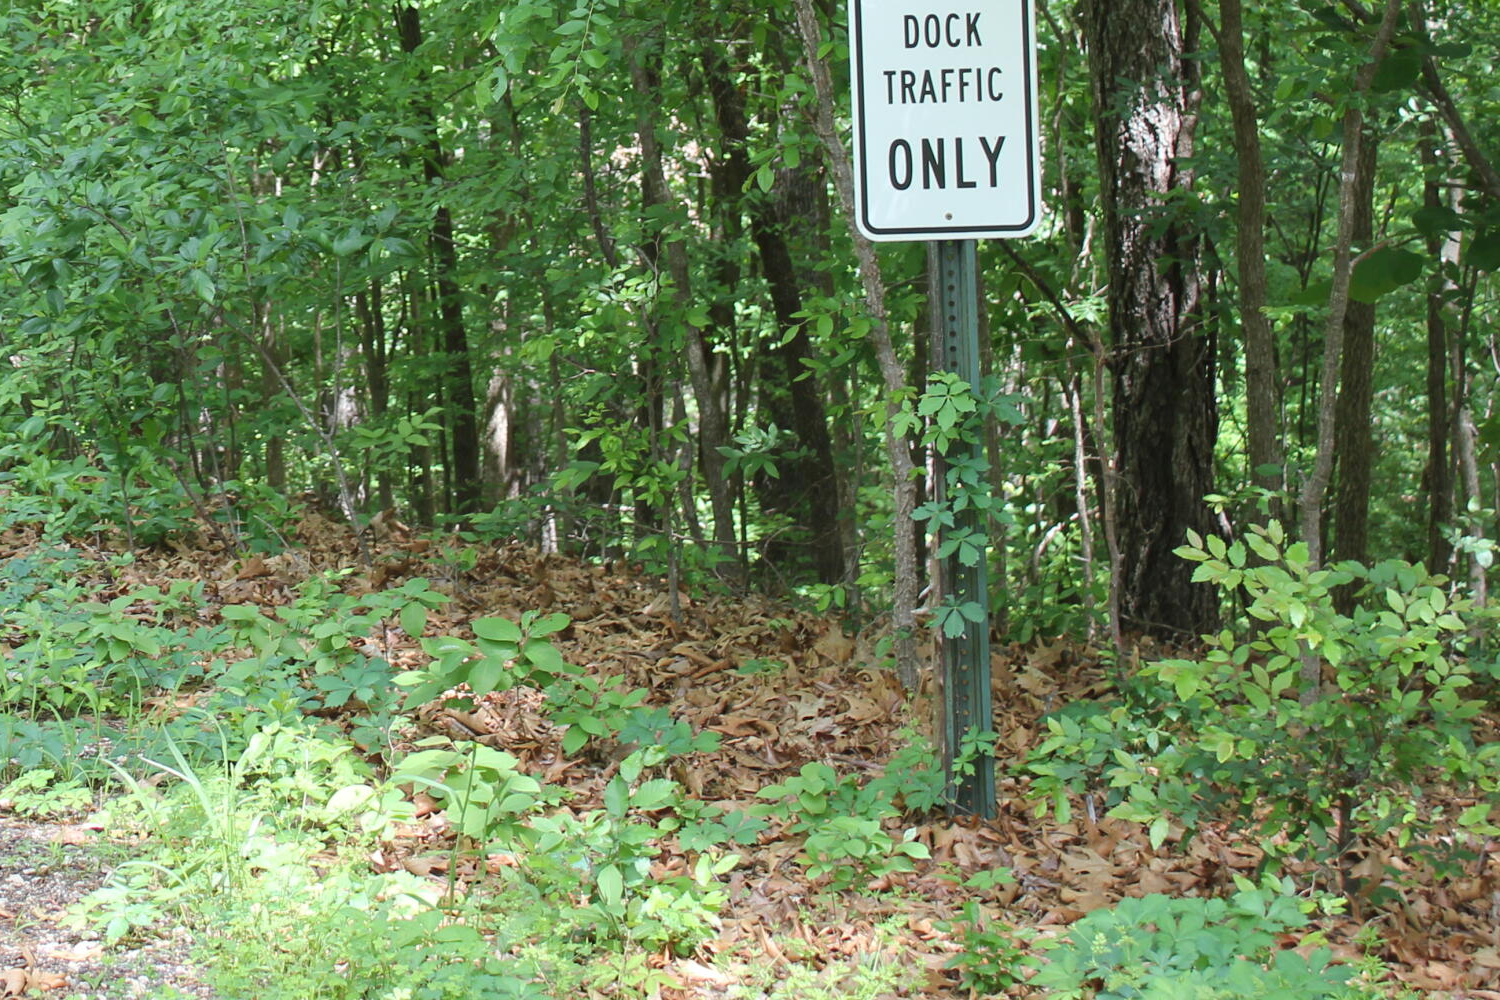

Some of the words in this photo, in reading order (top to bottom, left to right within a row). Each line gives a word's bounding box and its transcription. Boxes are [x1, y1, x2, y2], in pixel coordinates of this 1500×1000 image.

[903, 12, 982, 48] DOCK
[883, 67, 1003, 104] TRAFFIC
[888, 136, 1006, 190] ONLY
